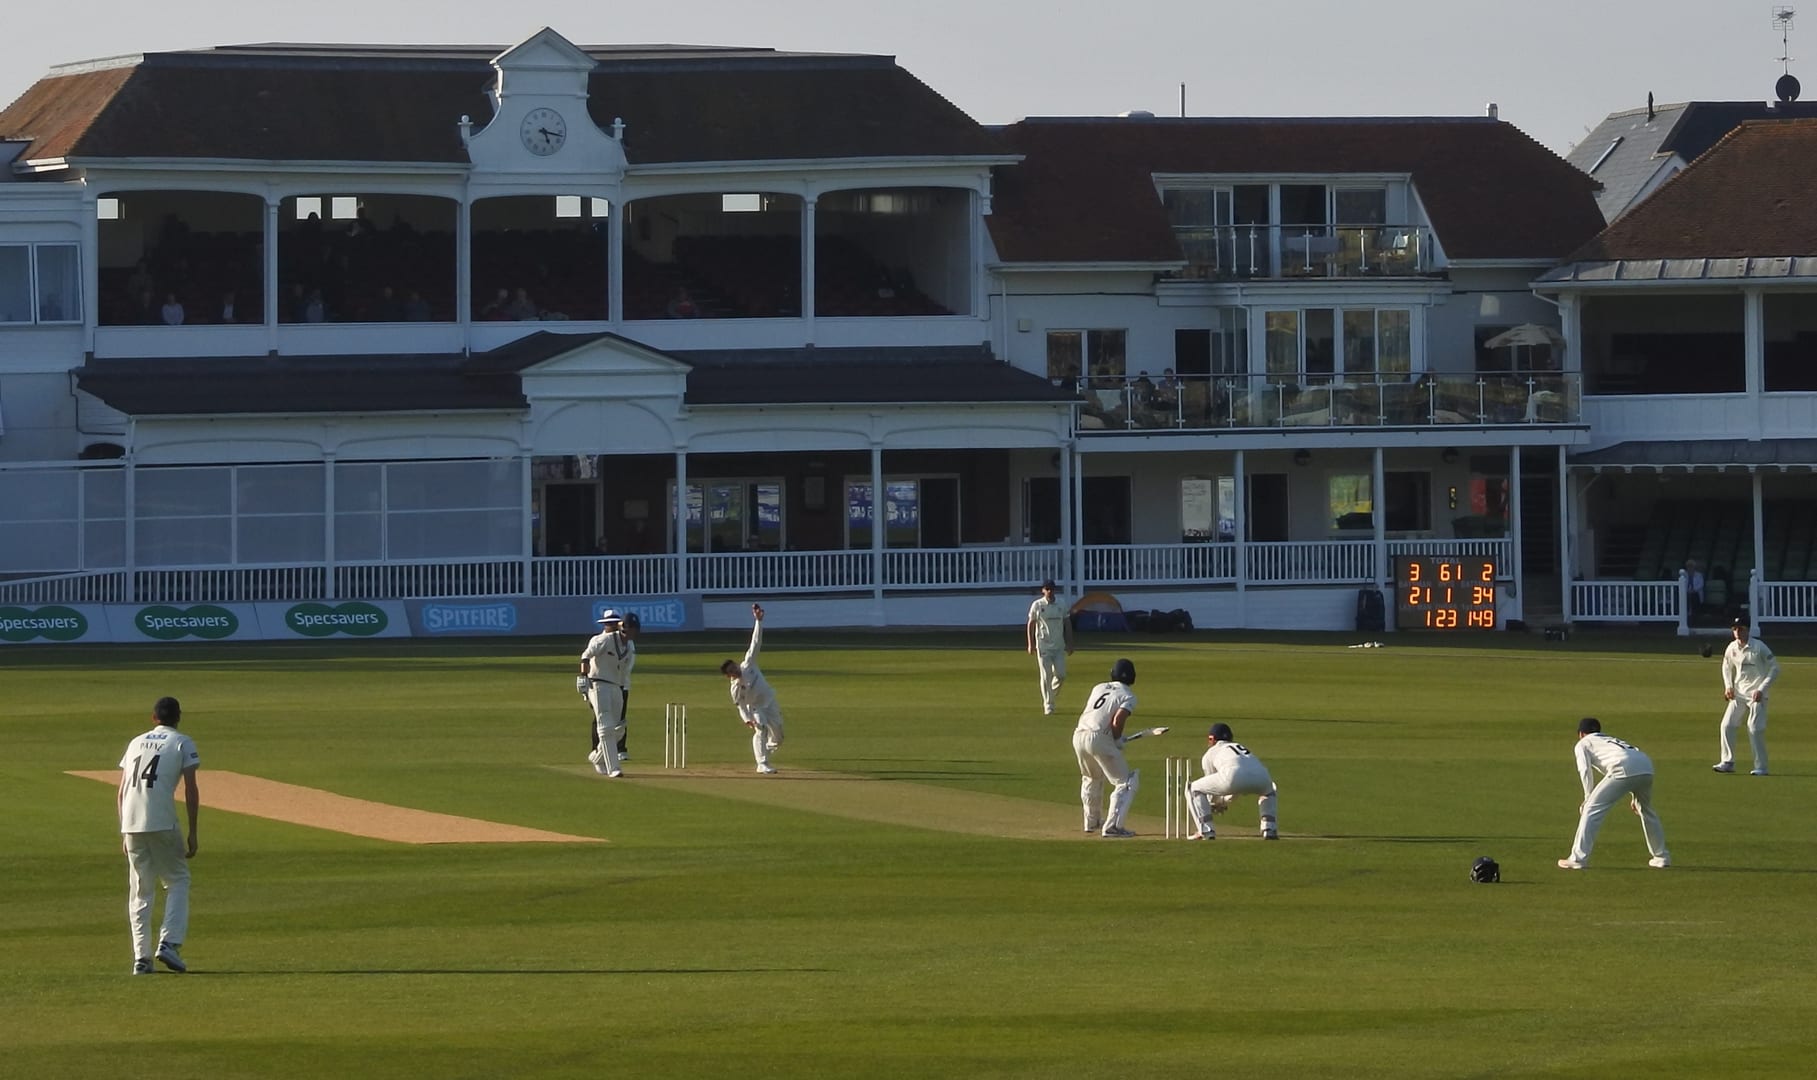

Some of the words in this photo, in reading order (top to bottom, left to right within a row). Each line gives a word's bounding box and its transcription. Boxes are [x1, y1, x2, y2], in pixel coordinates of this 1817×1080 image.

[1430, 557, 1461, 565] TOTAL
[1409, 563, 1421, 582] 3
[1440, 563, 1462, 582] 61
[1482, 563, 1494, 582] 2
[1409, 586, 1431, 605] 21
[1472, 586, 1494, 605] 34
[144, 614, 230, 631] Specsavers
[294, 611, 379, 628] Specsavers
[429, 606, 509, 629] SPITFIRE
[600, 604, 677, 624] TFIRE
[1468, 609, 1493, 628] 149
[1093, 691, 1111, 710] 6
[1226, 744, 1250, 756] 19
[132, 754, 160, 788] 14
